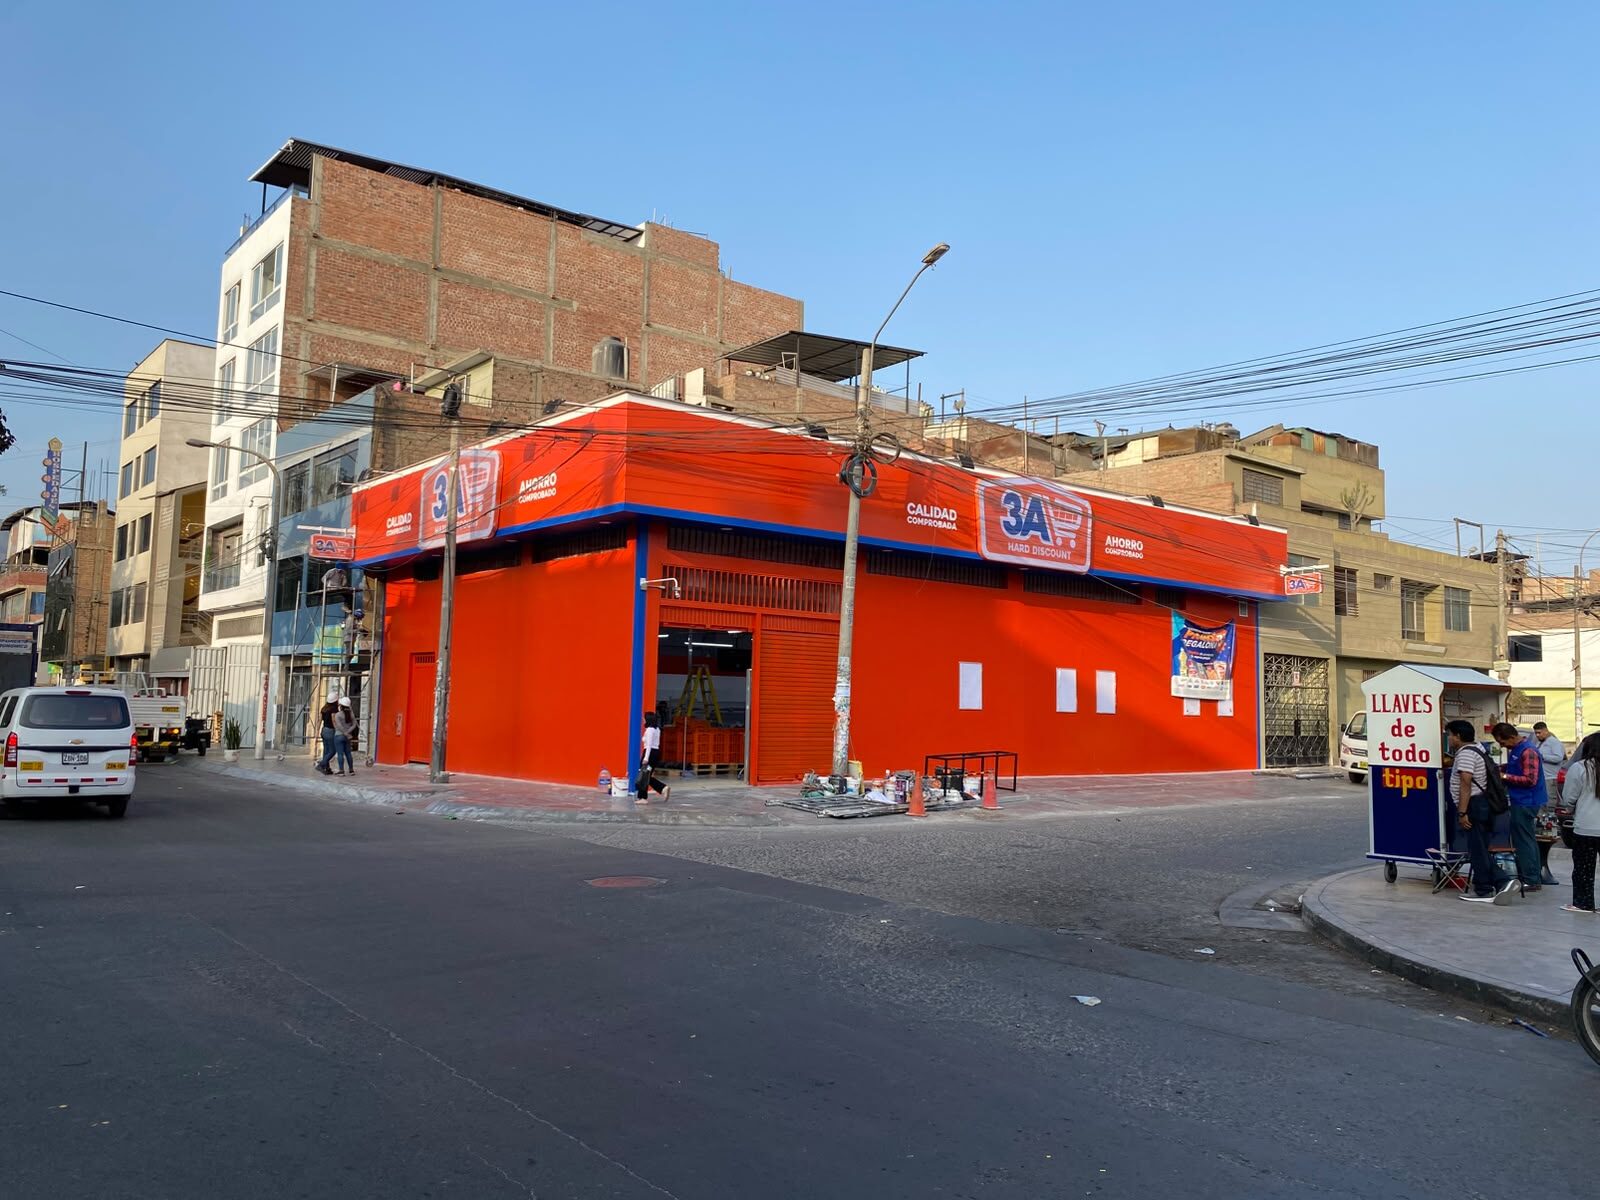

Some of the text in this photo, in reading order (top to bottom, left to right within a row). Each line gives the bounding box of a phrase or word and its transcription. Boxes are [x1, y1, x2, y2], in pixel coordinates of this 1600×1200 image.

[519, 472, 557, 494] AHORRO
[518, 487, 557, 504] COMPROBADO
[386, 512, 412, 529] CALIDAD
[907, 502, 957, 521] CALIDAD
[1002, 490, 1052, 543] 3A
[907, 516, 958, 530] COMPROBADA
[315, 539, 336, 552] 3A
[1007, 542, 1072, 560] HARD DISCOUNT
[1105, 535, 1144, 551] AHORRO
[1104, 547, 1144, 559] COMPROBADO
[1290, 579, 1306, 590] 3A
[1371, 693, 1433, 714] LLAVES
[1391, 718, 1416, 738] de
[1379, 741, 1430, 763] todo
[1383, 768, 1428, 798] tipo
